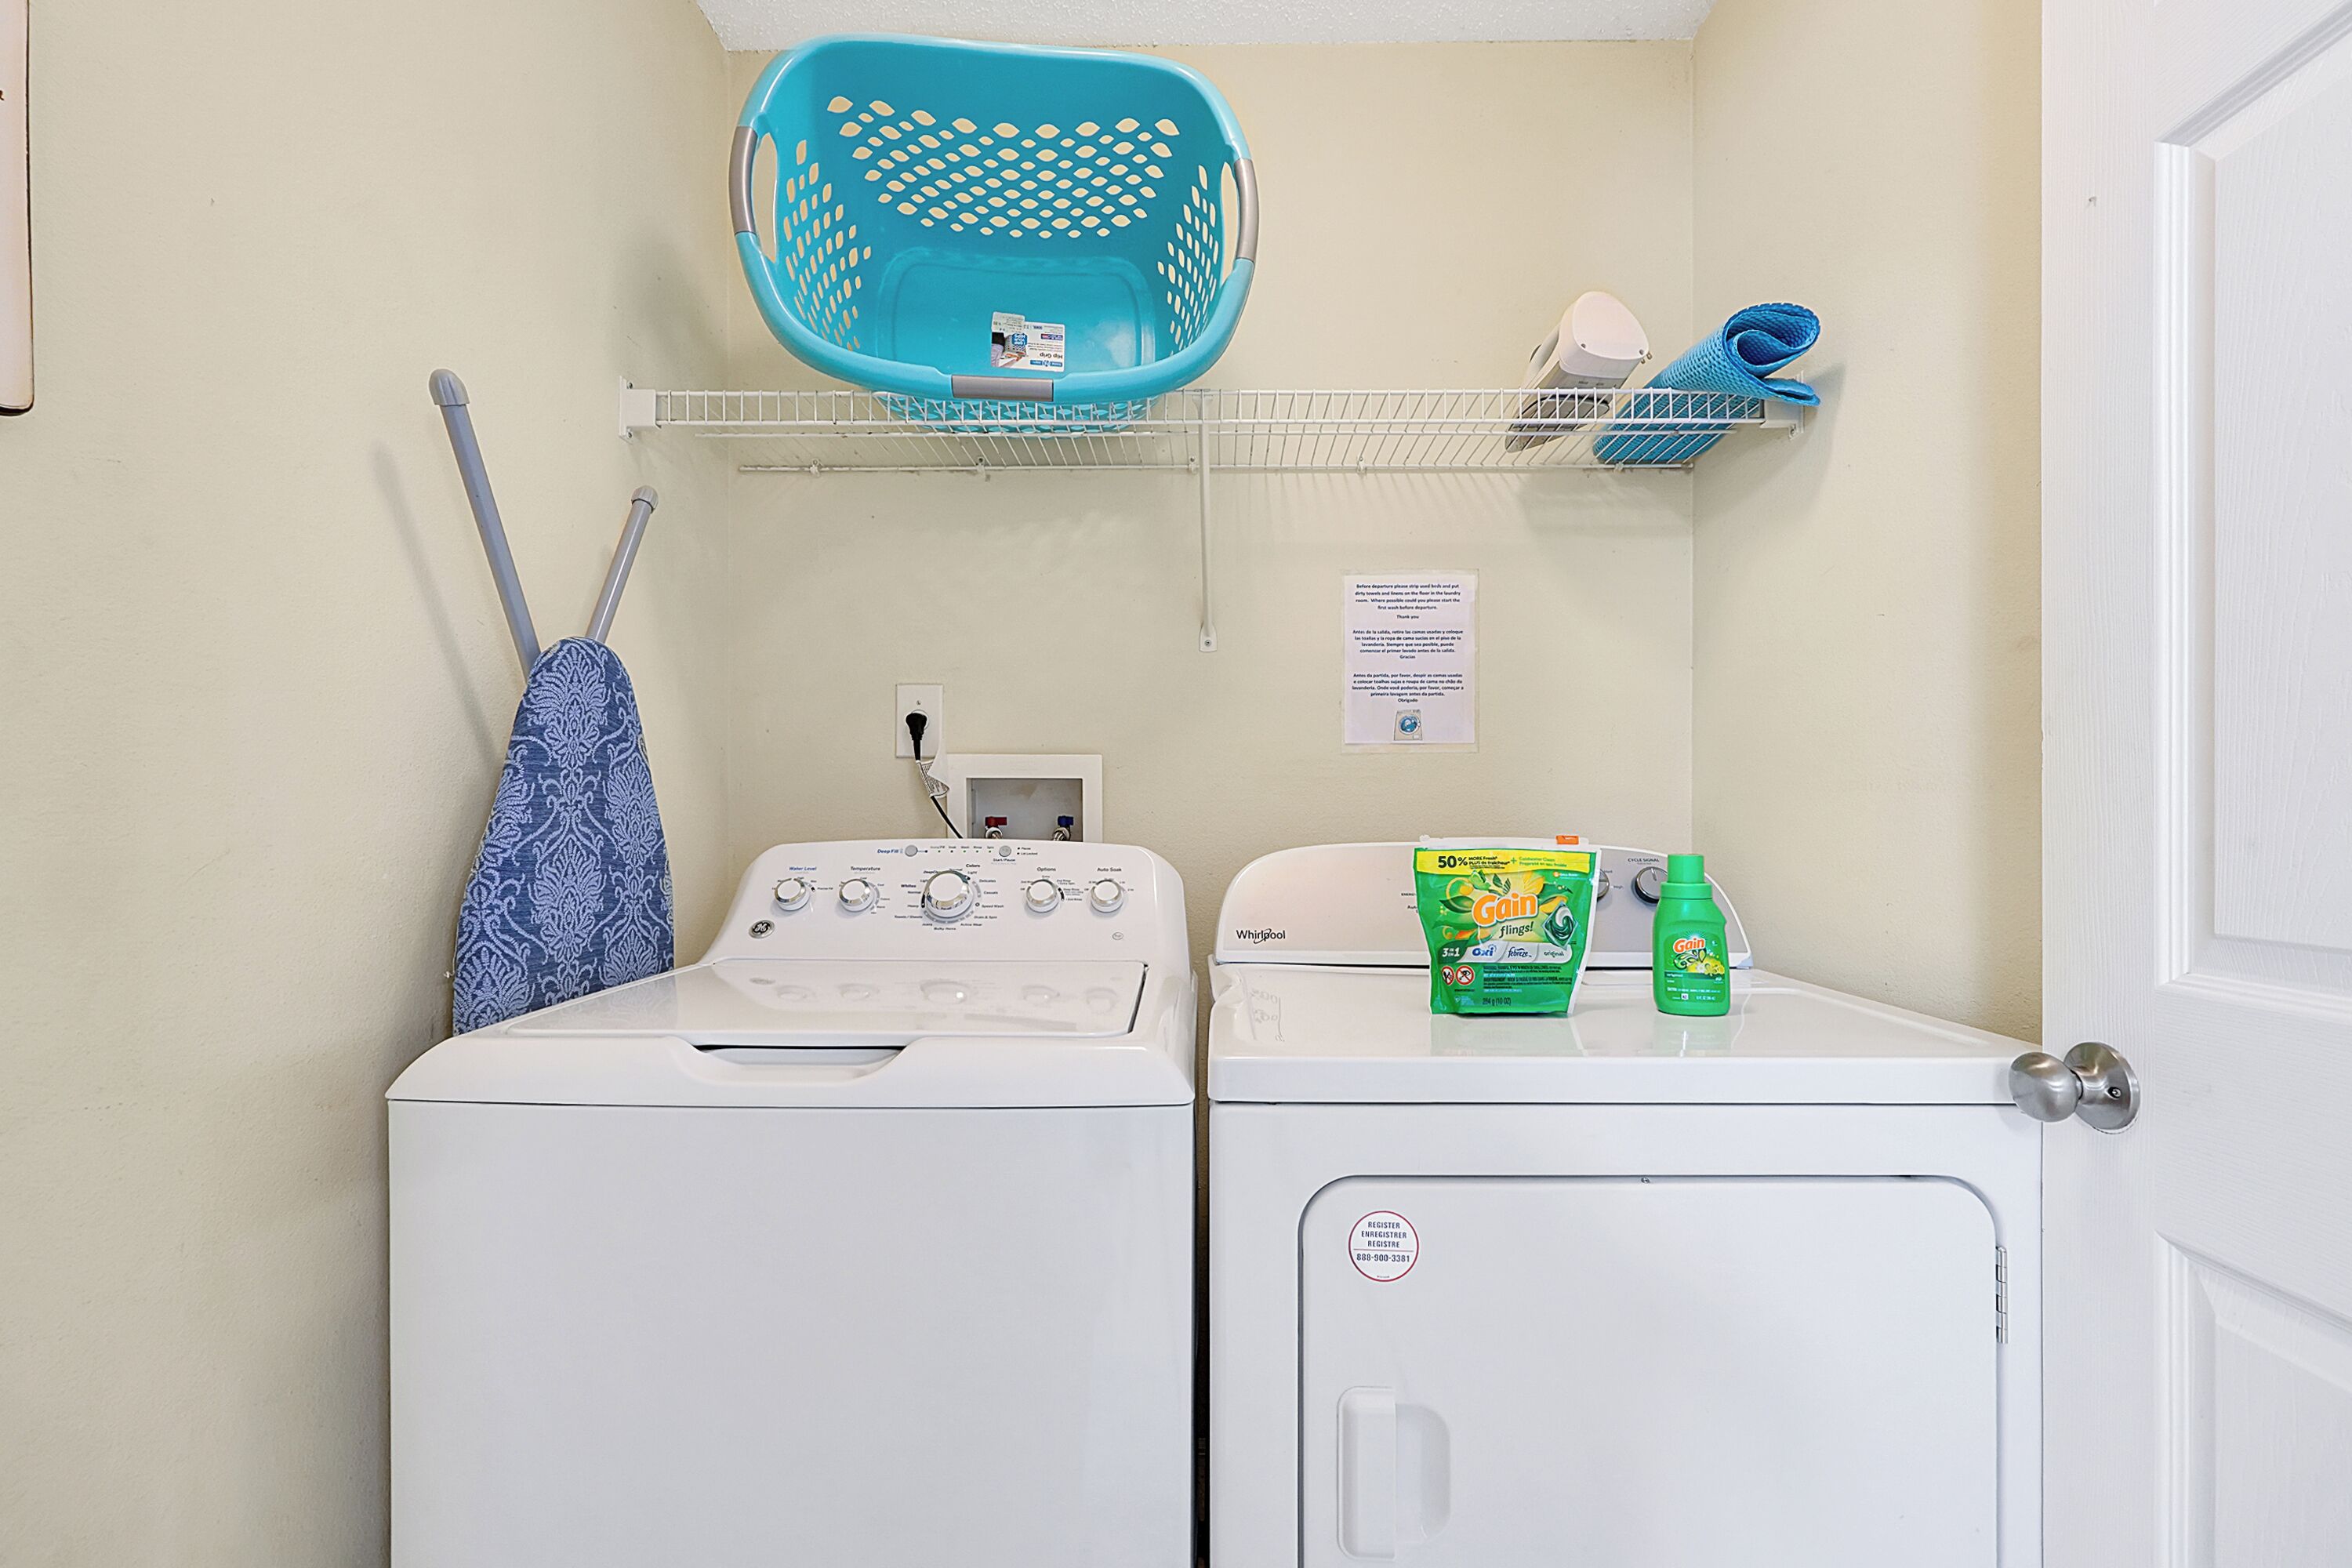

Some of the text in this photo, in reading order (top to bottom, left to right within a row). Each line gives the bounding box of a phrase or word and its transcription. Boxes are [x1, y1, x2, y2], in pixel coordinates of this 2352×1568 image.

[1438, 855, 1468, 868] 50%
[1472, 892, 1537, 926] Gain
[1236, 928, 1286, 944] Whirlpool
[1499, 921, 1534, 938] flings!
[1443, 947, 1448, 956] 3
[1454, 947, 1460, 956] 1
[1508, 946, 1529, 958] febreze
[1673, 938, 1705, 953] Gain
[1361, 1230, 1406, 1239] ENREGISTRER
[1356, 1253, 1410, 1262] 888-900-3381
